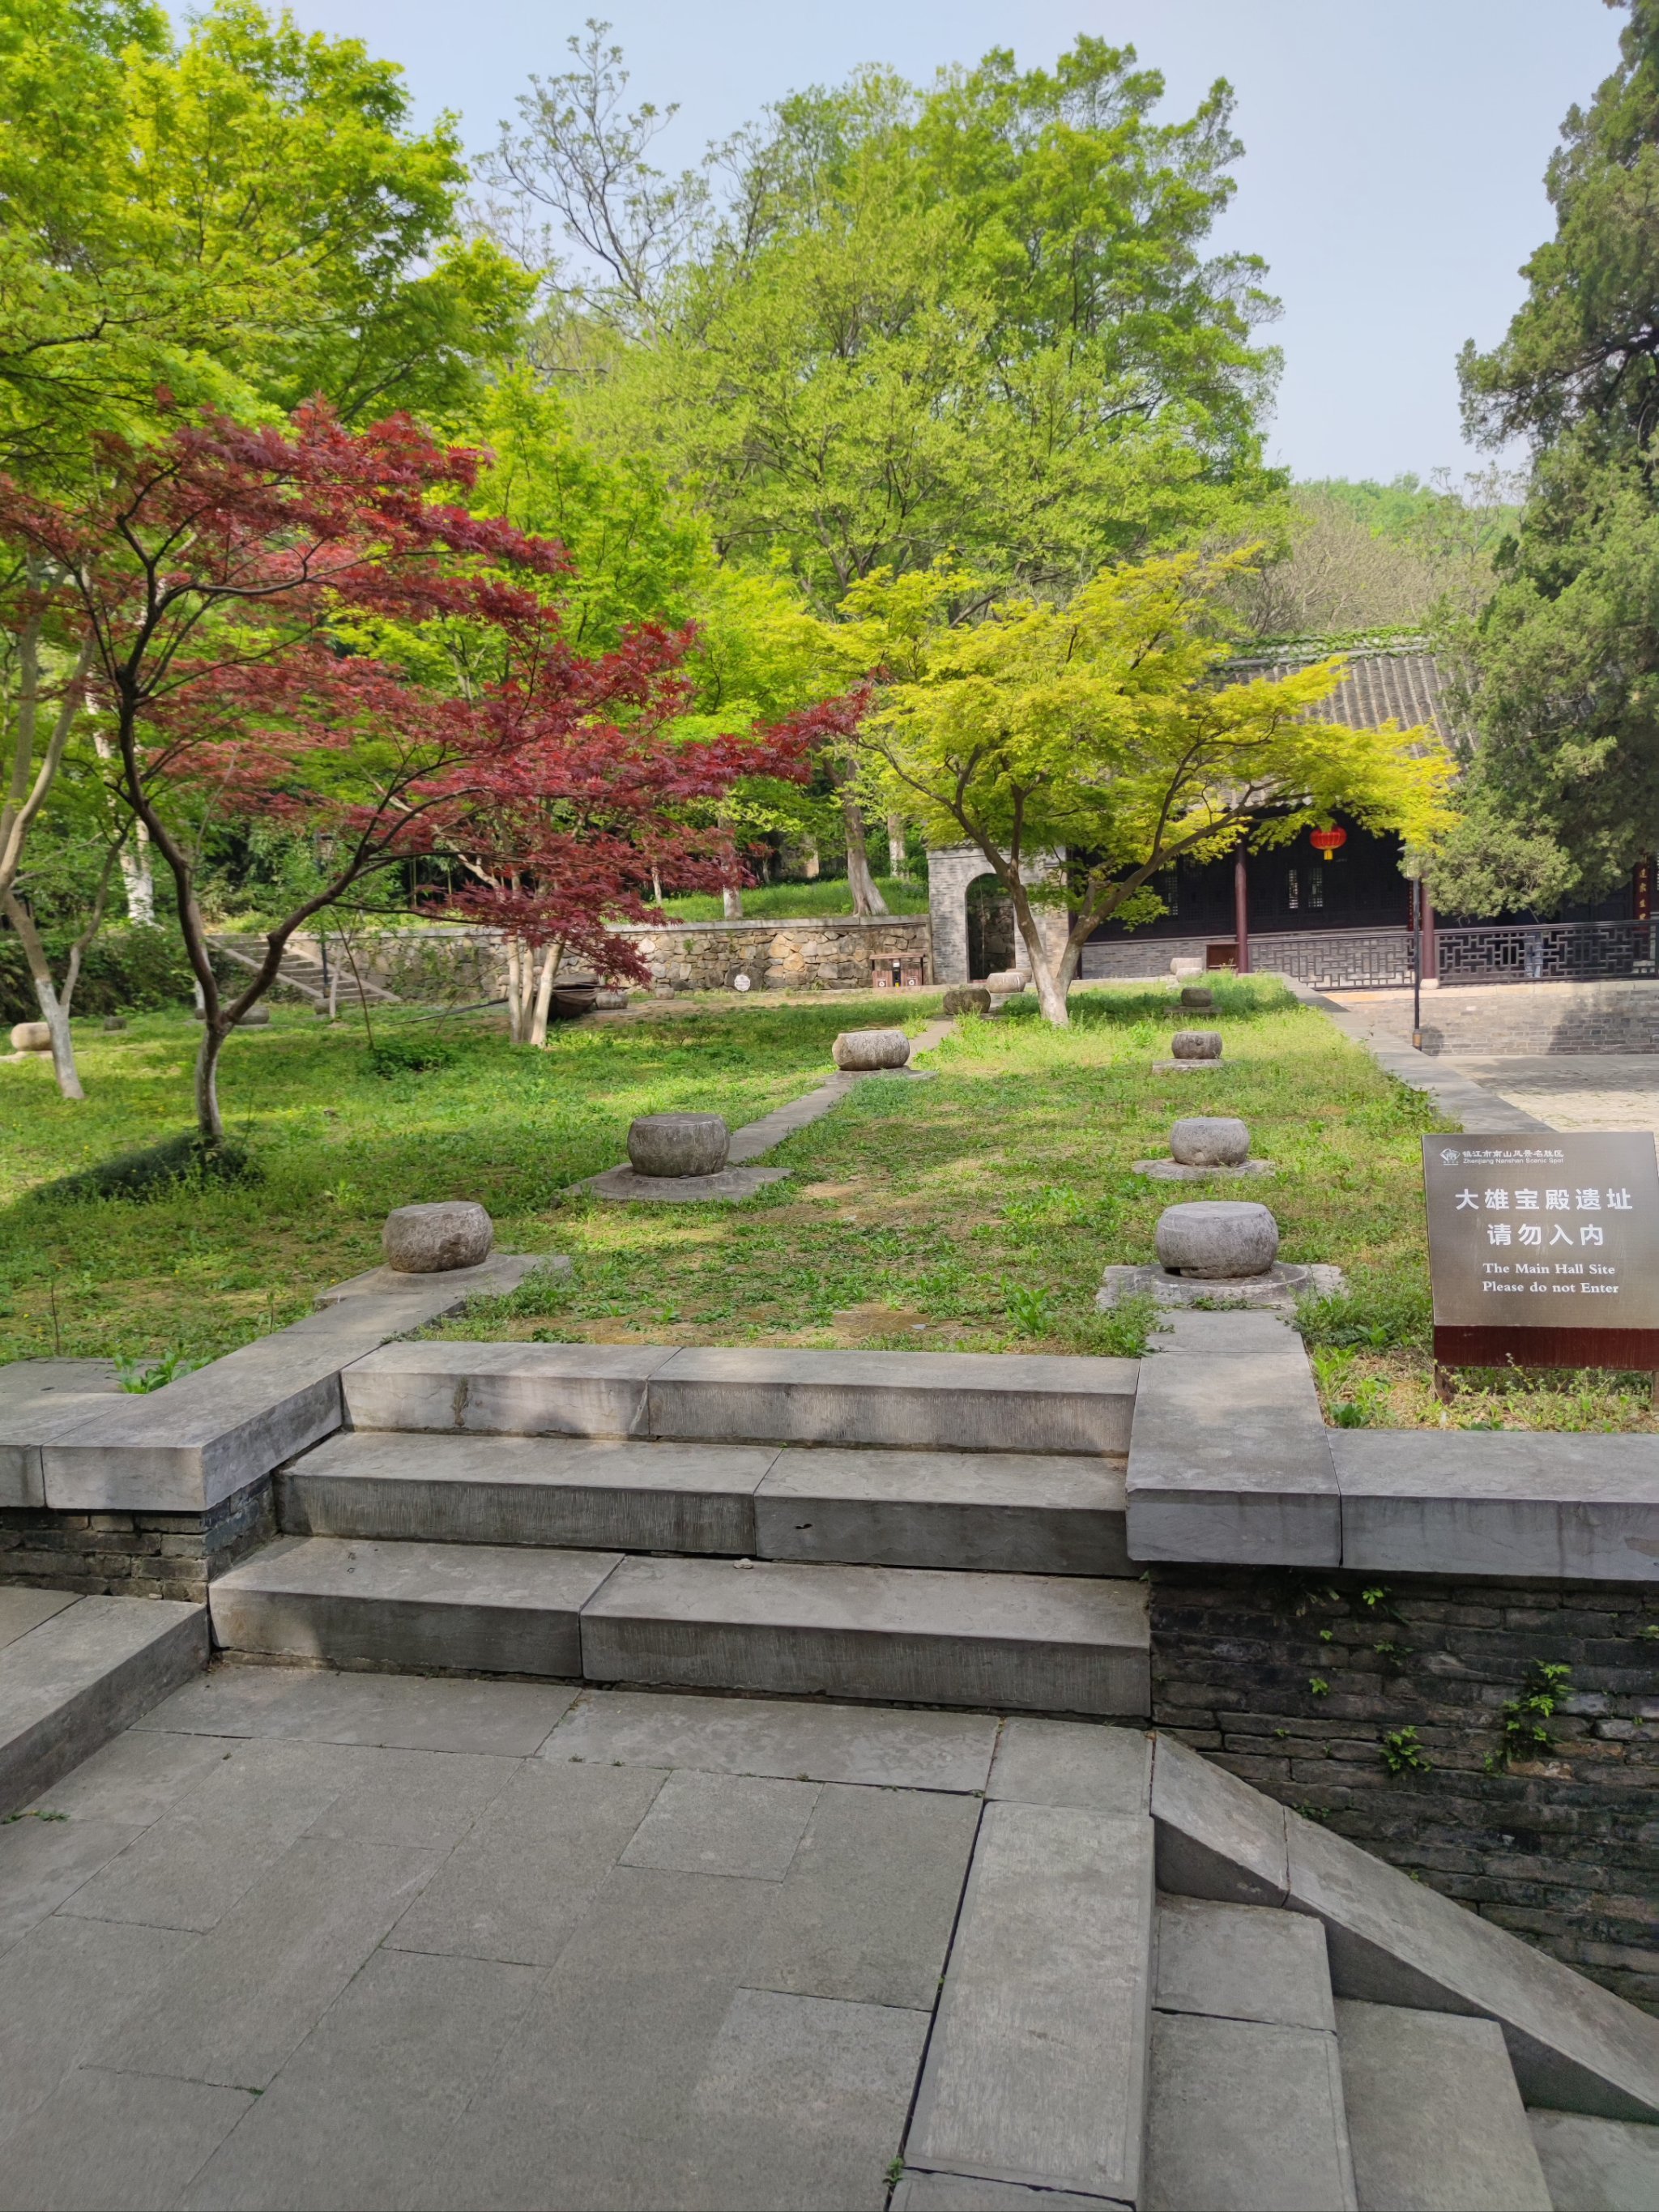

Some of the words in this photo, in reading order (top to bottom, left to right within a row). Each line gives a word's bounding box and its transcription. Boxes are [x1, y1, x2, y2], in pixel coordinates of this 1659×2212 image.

[1455, 1188, 1632, 1210] 大雄宝殿遗址
[1487, 1224, 1603, 1246] 请勿入内
[1482, 1263, 1510, 1273] The
[1515, 1264, 1550, 1274] Main
[1555, 1264, 1584, 1274] Hall
[1589, 1264, 1615, 1274] Site
[1482, 1281, 1525, 1292] Please
[1529, 1281, 1547, 1292] do
[1552, 1283, 1576, 1293] not
[1580, 1283, 1619, 1294] Enter
